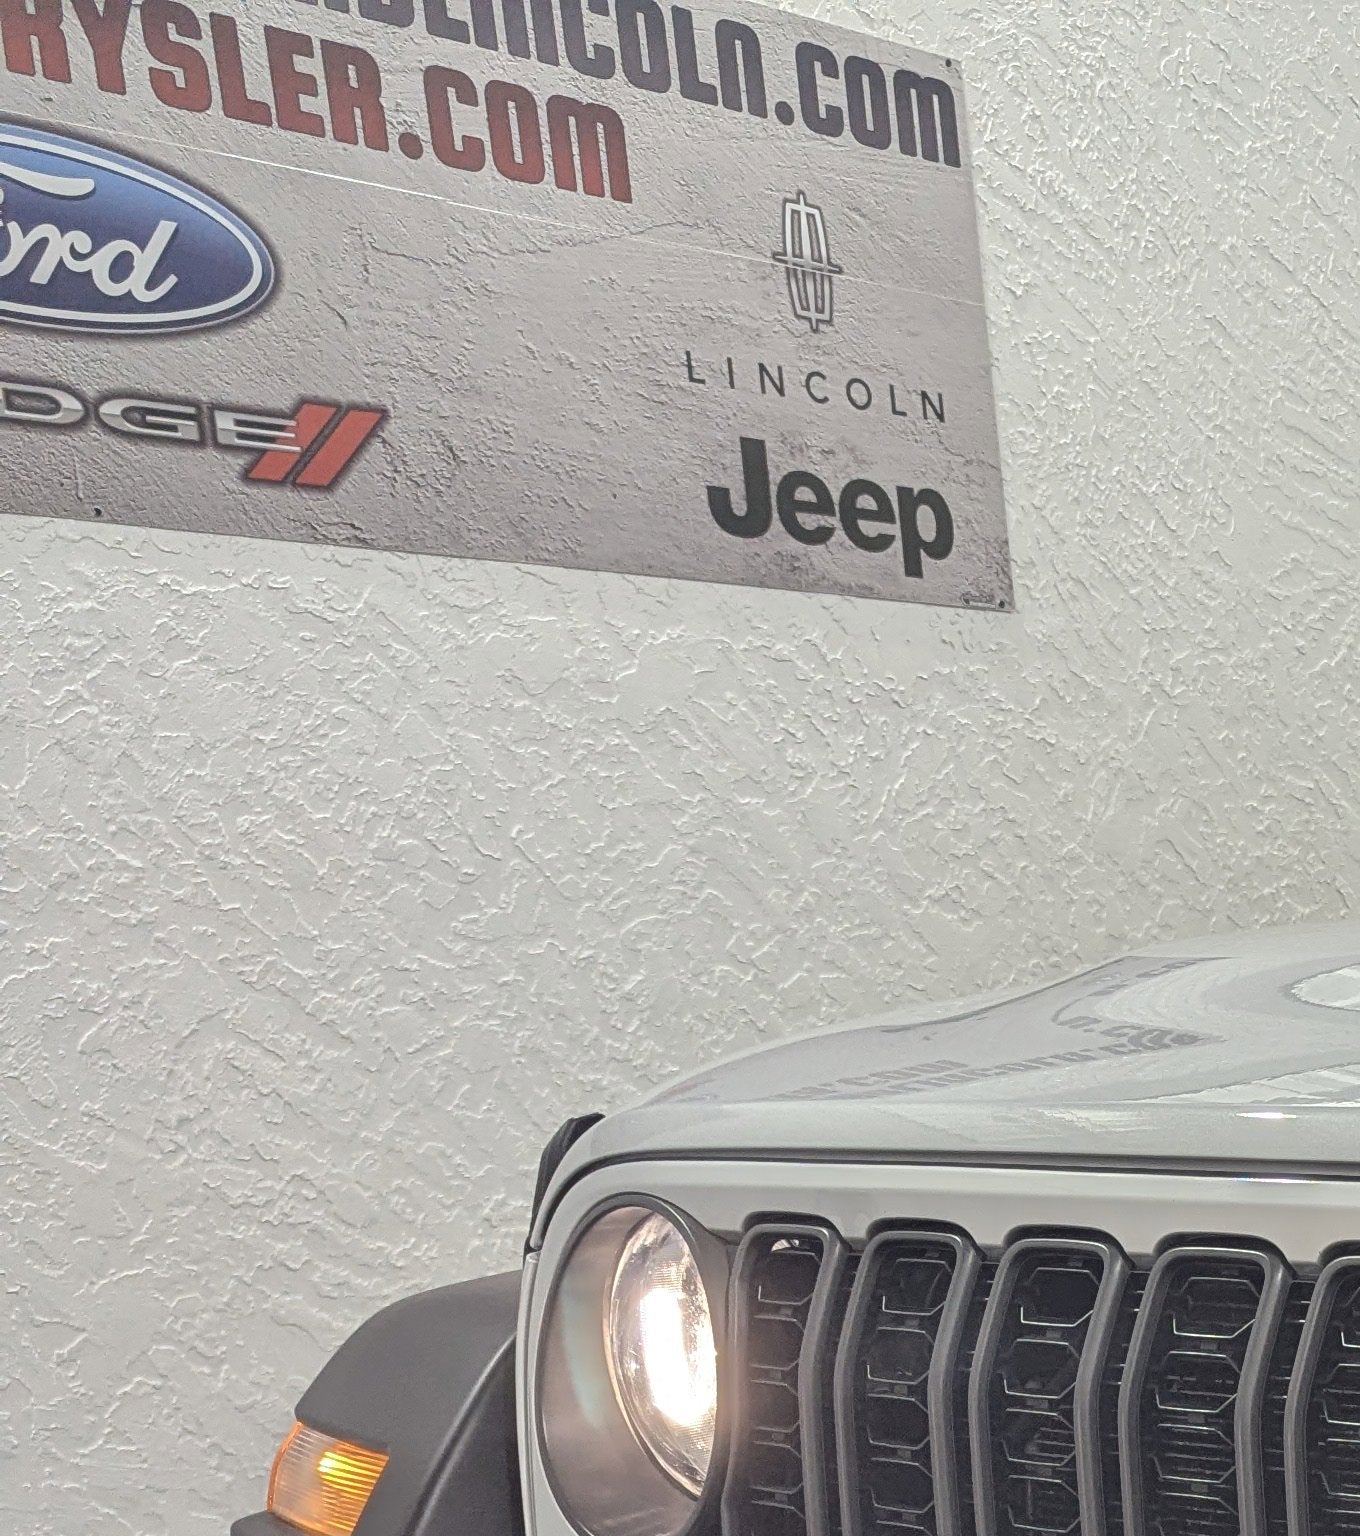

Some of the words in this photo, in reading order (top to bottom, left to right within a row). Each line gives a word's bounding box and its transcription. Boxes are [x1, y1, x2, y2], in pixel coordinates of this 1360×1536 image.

[285, 0, 962, 168] LINCOLN.COM
[0, 162, 179, 303] rd
[685, 350, 946, 423] LINCOLN
[706, 436, 955, 579] Jeep
